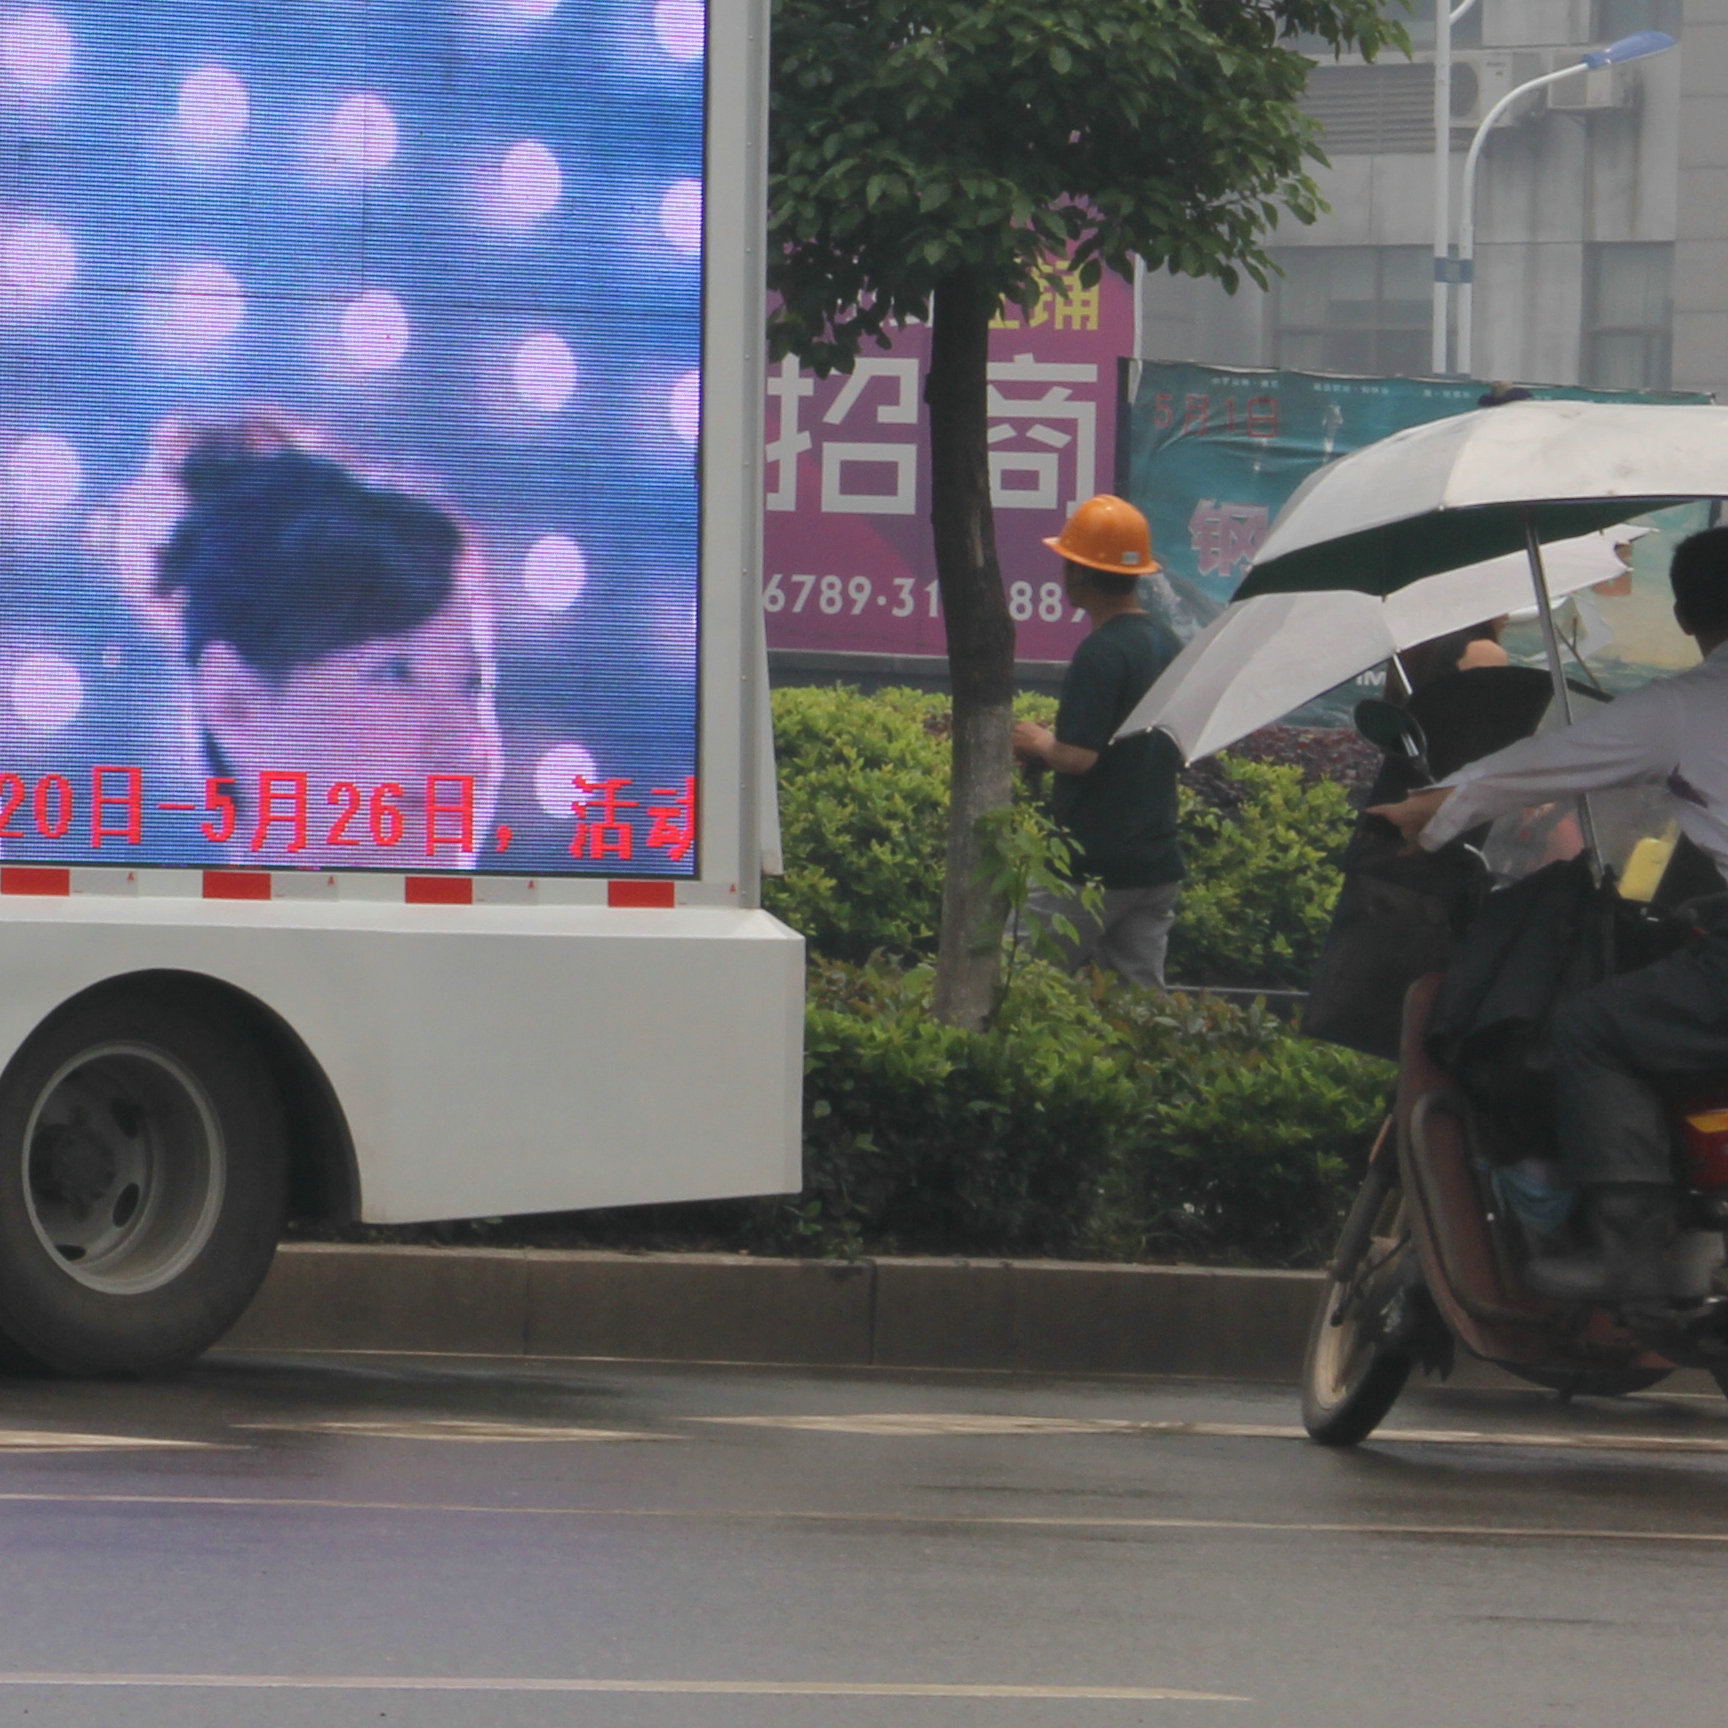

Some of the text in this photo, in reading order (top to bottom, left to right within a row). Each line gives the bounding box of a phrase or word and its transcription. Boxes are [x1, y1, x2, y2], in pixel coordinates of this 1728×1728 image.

[987, 260, 1099, 330] 铺
[765, 351, 1099, 520] 招商
[1153, 393, 1279, 438] 5月1日
